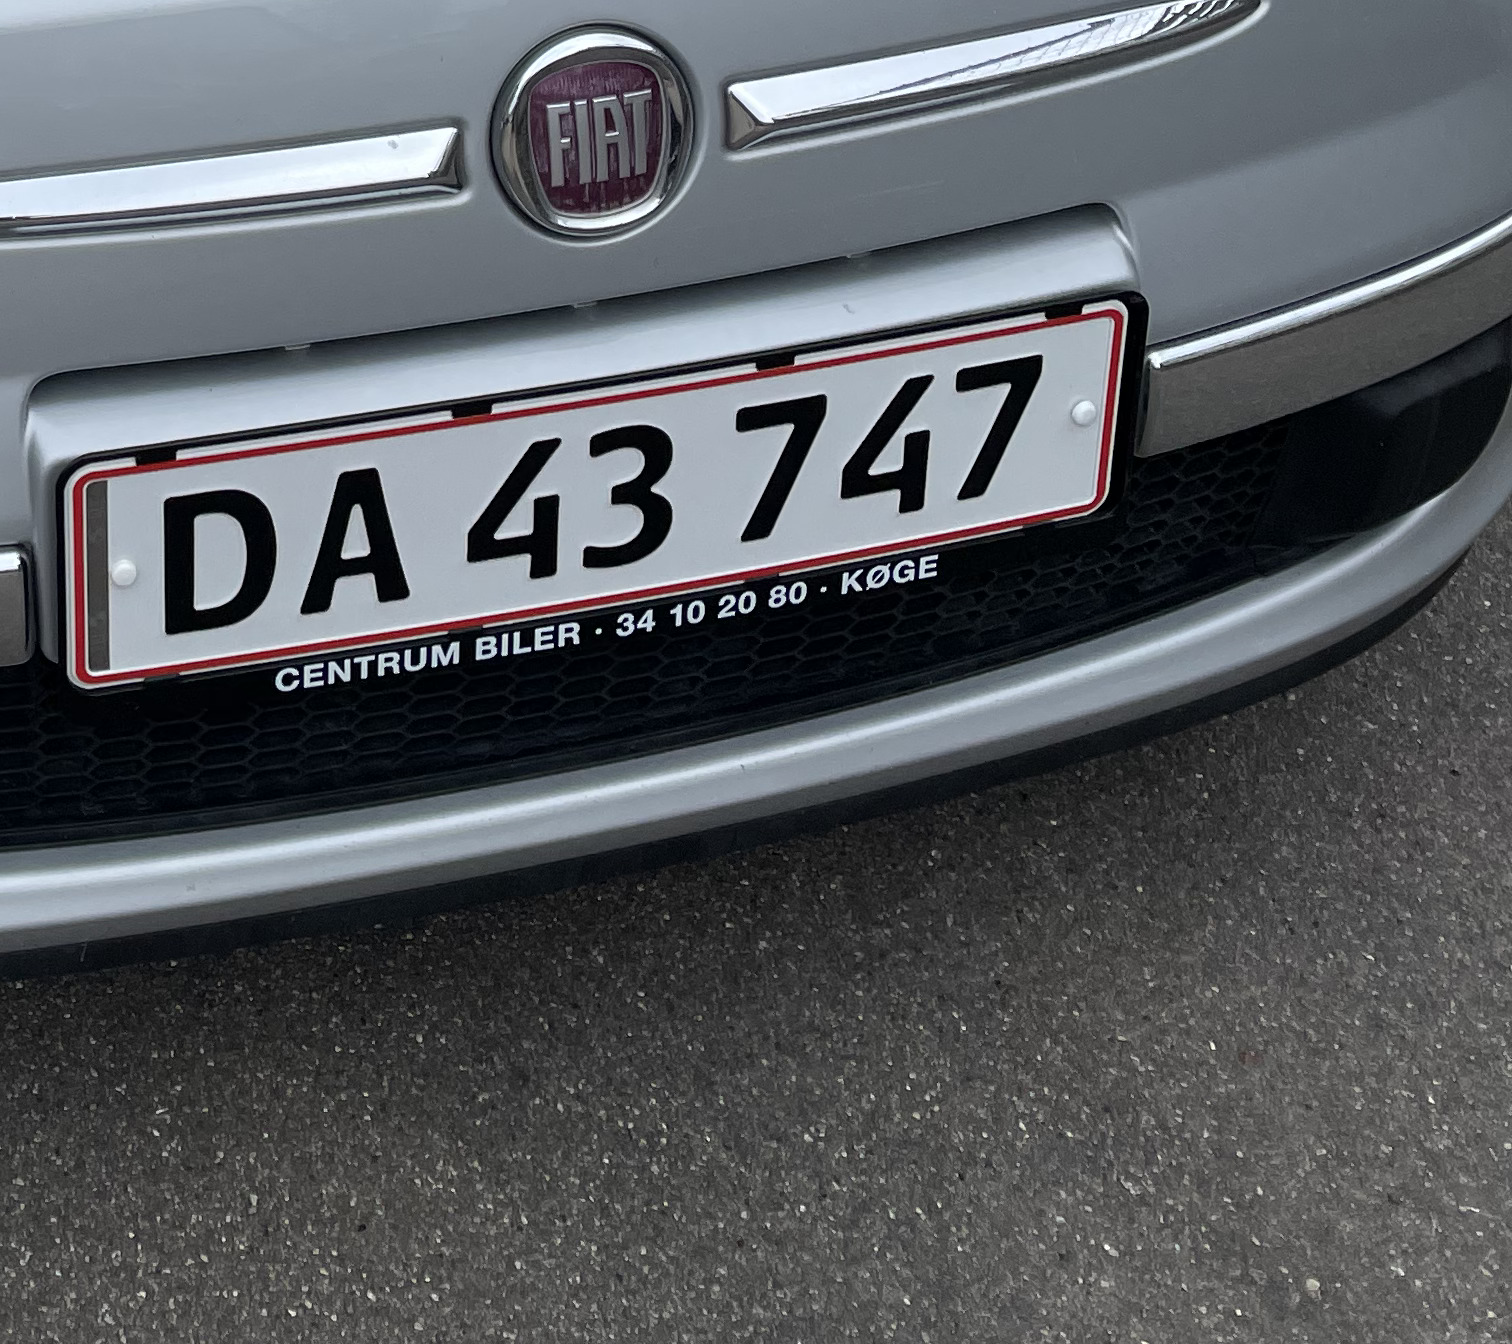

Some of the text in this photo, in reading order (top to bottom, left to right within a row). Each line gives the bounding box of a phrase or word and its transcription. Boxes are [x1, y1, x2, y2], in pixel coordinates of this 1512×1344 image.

[546, 88, 652, 188] FIAT
[163, 354, 1043, 636] DA 43 747
[274, 641, 461, 692] CENTRUM
[474, 621, 581, 662] BILER
[615, 609, 656, 637] 34
[669, 600, 706, 627] 10
[717, 591, 757, 619] 20
[767, 581, 808, 609] 80
[840, 553, 939, 596] KØGE
